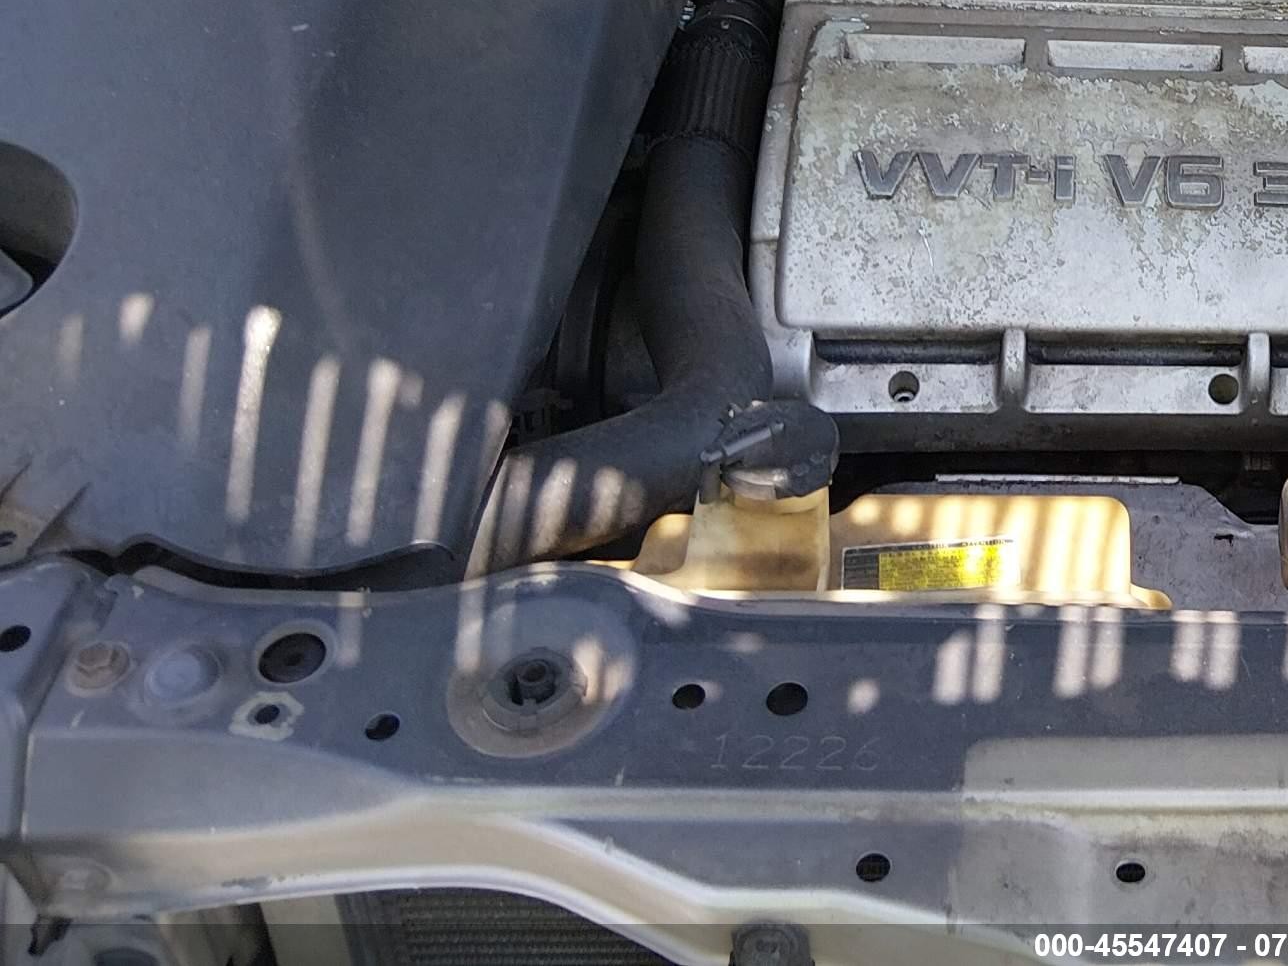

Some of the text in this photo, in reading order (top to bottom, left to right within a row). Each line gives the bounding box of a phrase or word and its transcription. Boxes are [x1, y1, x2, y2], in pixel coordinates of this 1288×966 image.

[855, 151, 1077, 203] VVT-i
[1103, 153, 1225, 209] V6
[710, 733, 881, 772] 12226
